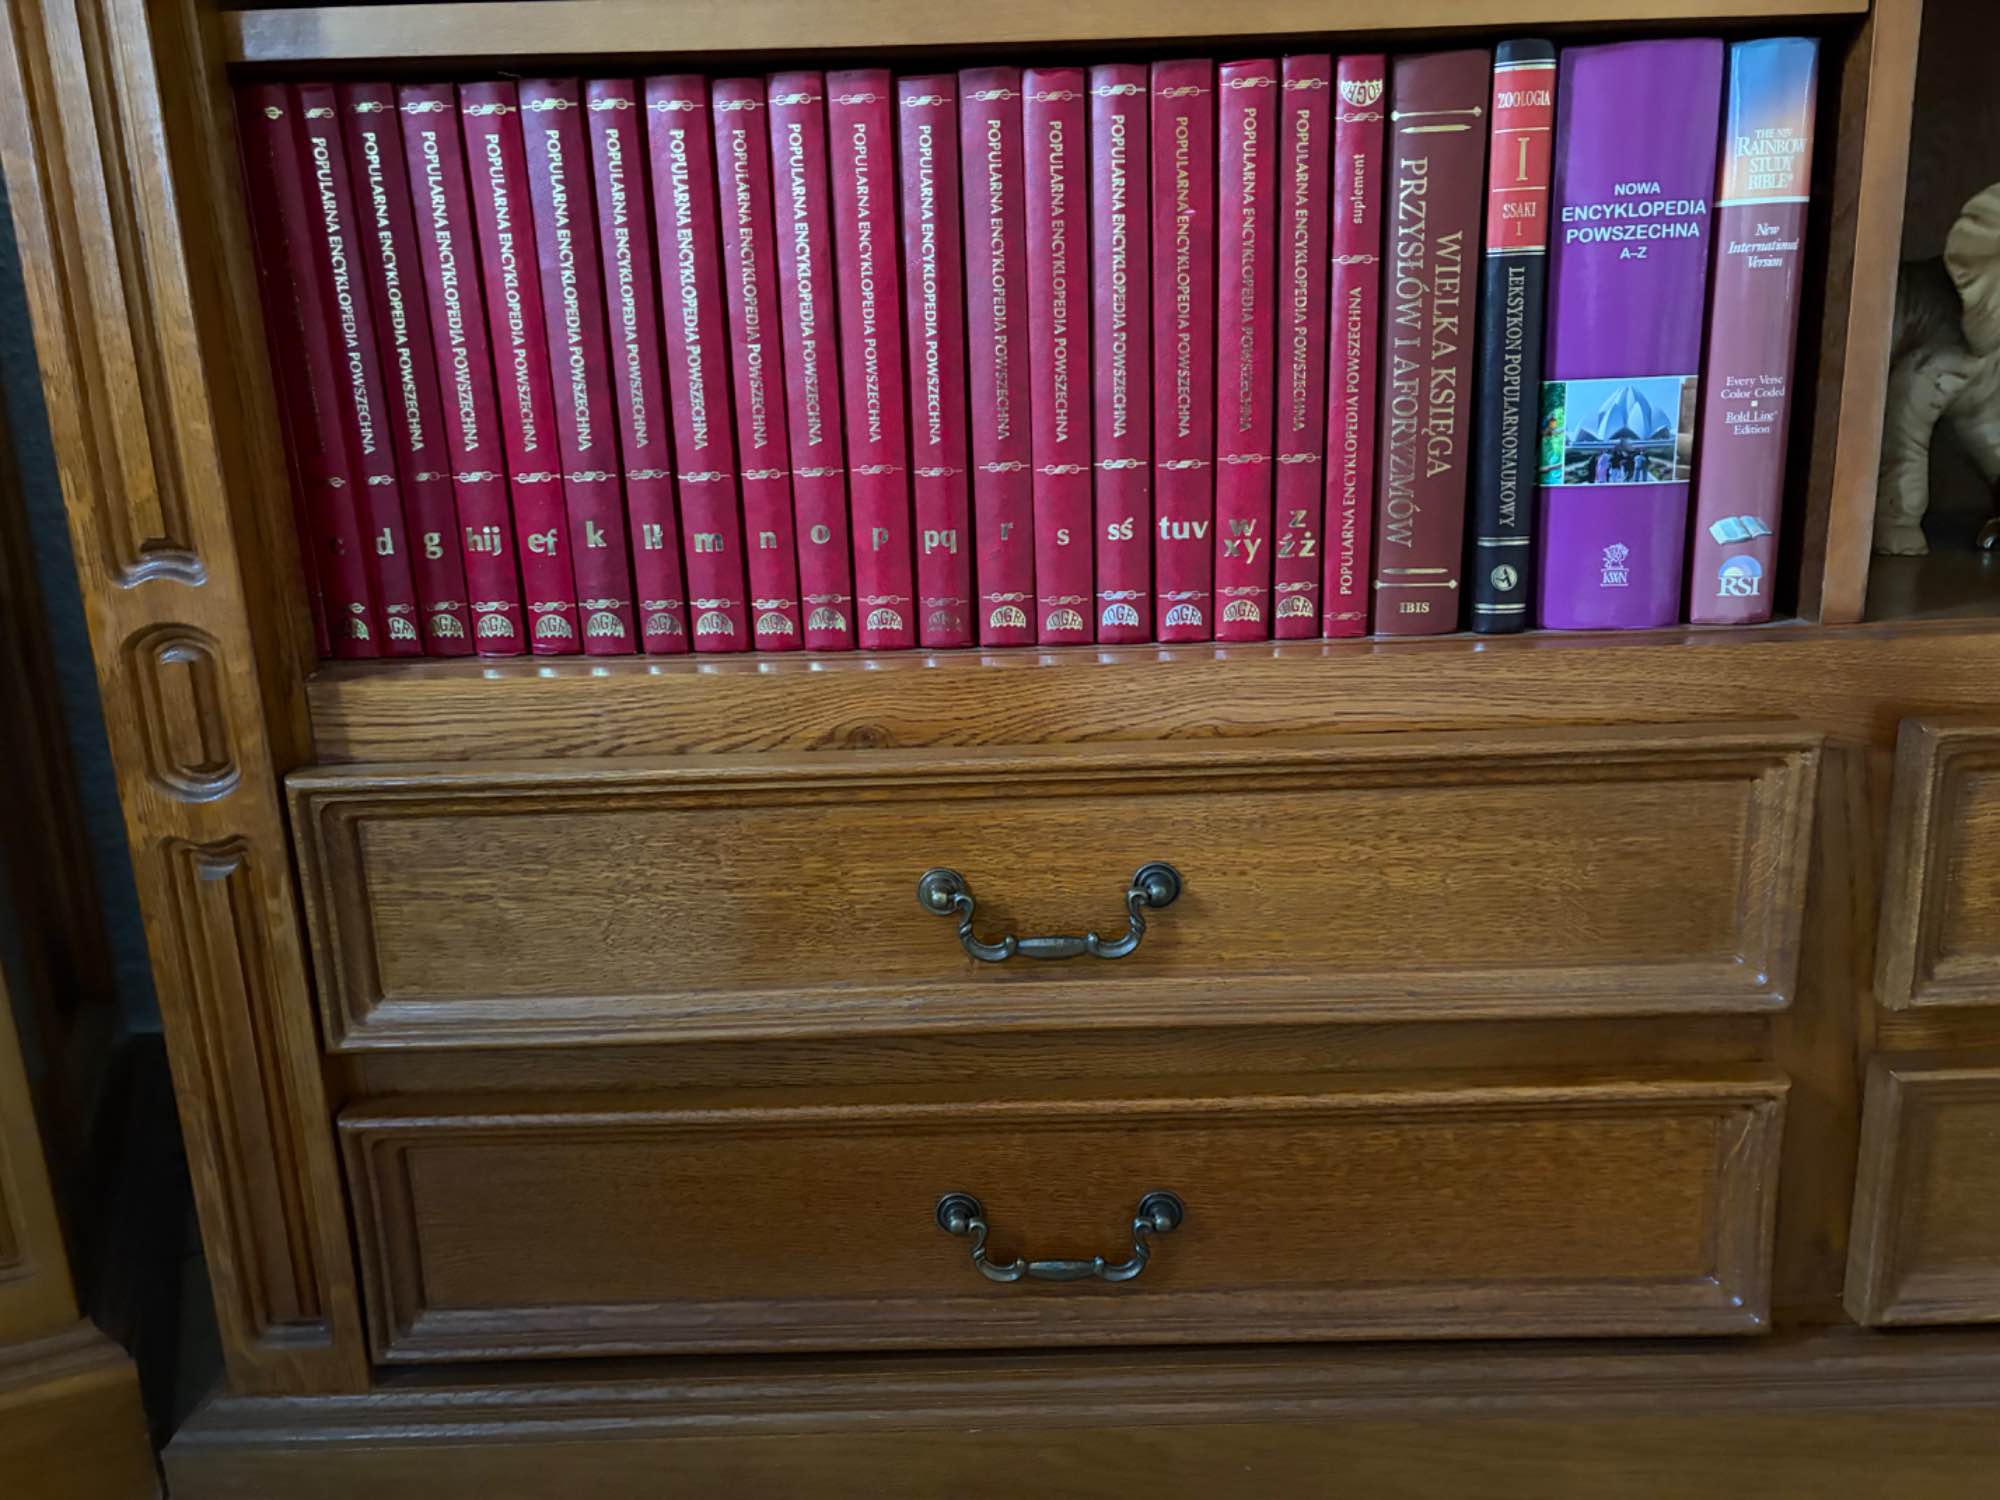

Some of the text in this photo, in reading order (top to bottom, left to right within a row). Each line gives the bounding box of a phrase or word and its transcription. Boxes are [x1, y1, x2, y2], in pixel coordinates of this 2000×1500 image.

[1497, 90, 1550, 108] ZOOLOGIA
[987, 120, 1003, 214] POPULARNA
[1242, 108, 1256, 204] POPULARNA
[1296, 110, 1310, 206] POPULARNA
[1516, 137, 1530, 180] I
[1736, 137, 1808, 157] RAINBOW
[1750, 156, 1794, 174] STUDY
[1350, 154, 1366, 224] suplement
[1502, 202, 1536, 218] SSAKI
[1614, 182, 1661, 196] NOWA
[1562, 200, 1706, 222] ENCYKLOPEDIA
[1754, 224, 1780, 236] New
[1566, 222, 1700, 244] POWSZECHNA
[1728, 237, 1800, 254] International
[606, 128, 648, 448] POPULARNA ENCYKLOPEDIA POWSZECHNA
[787, 124, 822, 446] POPULARNA ENCYKLOPEDIA POWSZECHNA
[852, 124, 882, 442] POPULARNA ENCYKLOPEDIA POWSZECHNA
[918, 126, 941, 444] POPULARNA ENCYKLOPEDIA POWSZECHNA
[991, 218, 1006, 332] ENCYKLOPEDIA
[1049, 121, 1068, 442] POPULARNA ENCYKLOPEDIA POWSZECHNA
[1110, 115, 1126, 438] POPULARNA ENCYKLOPEDIA POWSZECHNA
[1175, 117, 1190, 438] POPULARNA ENCYKLOPEDIA POWSZECHNA
[1294, 210, 1308, 323] ENCYKLOPEDIA
[312, 136, 376, 454] POPULARNA ENCYKLOPEDIA POWSZECHNA
[362, 133, 424, 452] POPULARNA ENCYKLOPEDIA POWSZECHNA
[422, 132, 479, 451] POPULARNA ENCYKLOPEDIA POWSZECHNA
[485, 134, 538, 452] POPULARNA ENCYKLOPEDIA POWSZECHNA
[546, 130, 592, 451] POPULARNA ENCYKLOPEDIA POWSZECHNA
[669, 129, 708, 450] POPULARNA ENCYKLOPEDIA POWSZECHNA
[732, 130, 768, 448] POPULARNA ENCYKLOPEDIA POWSZECHNA
[1386, 156, 1430, 548] PRZYSŁÓW I AFORYZMÓW
[1422, 231, 1463, 478] WIELKA KSIĘGA
[1499, 266, 1525, 528] LEKSYKON POPULARNONAUKOWY
[1720, 384, 1786, 400] Color Coded
[1726, 376, 1756, 388] Every
[1340, 287, 1362, 595] POPULARNA ENCYKLOPEDIA POWSZECHNA
[424, 532, 443, 559] g
[466, 526, 502, 556] hij
[528, 529, 558, 556] ef
[586, 521, 607, 548] k
[694, 532, 723, 552] m
[759, 531, 777, 548] n
[872, 527, 888, 552] p
[924, 529, 957, 554] pq
[1057, 529, 1070, 545] s
[1108, 516, 1134, 540] sś
[1159, 516, 1208, 540] tuv
[1716, 576, 1762, 596] RSI
[1400, 602, 1430, 614] IBIS
